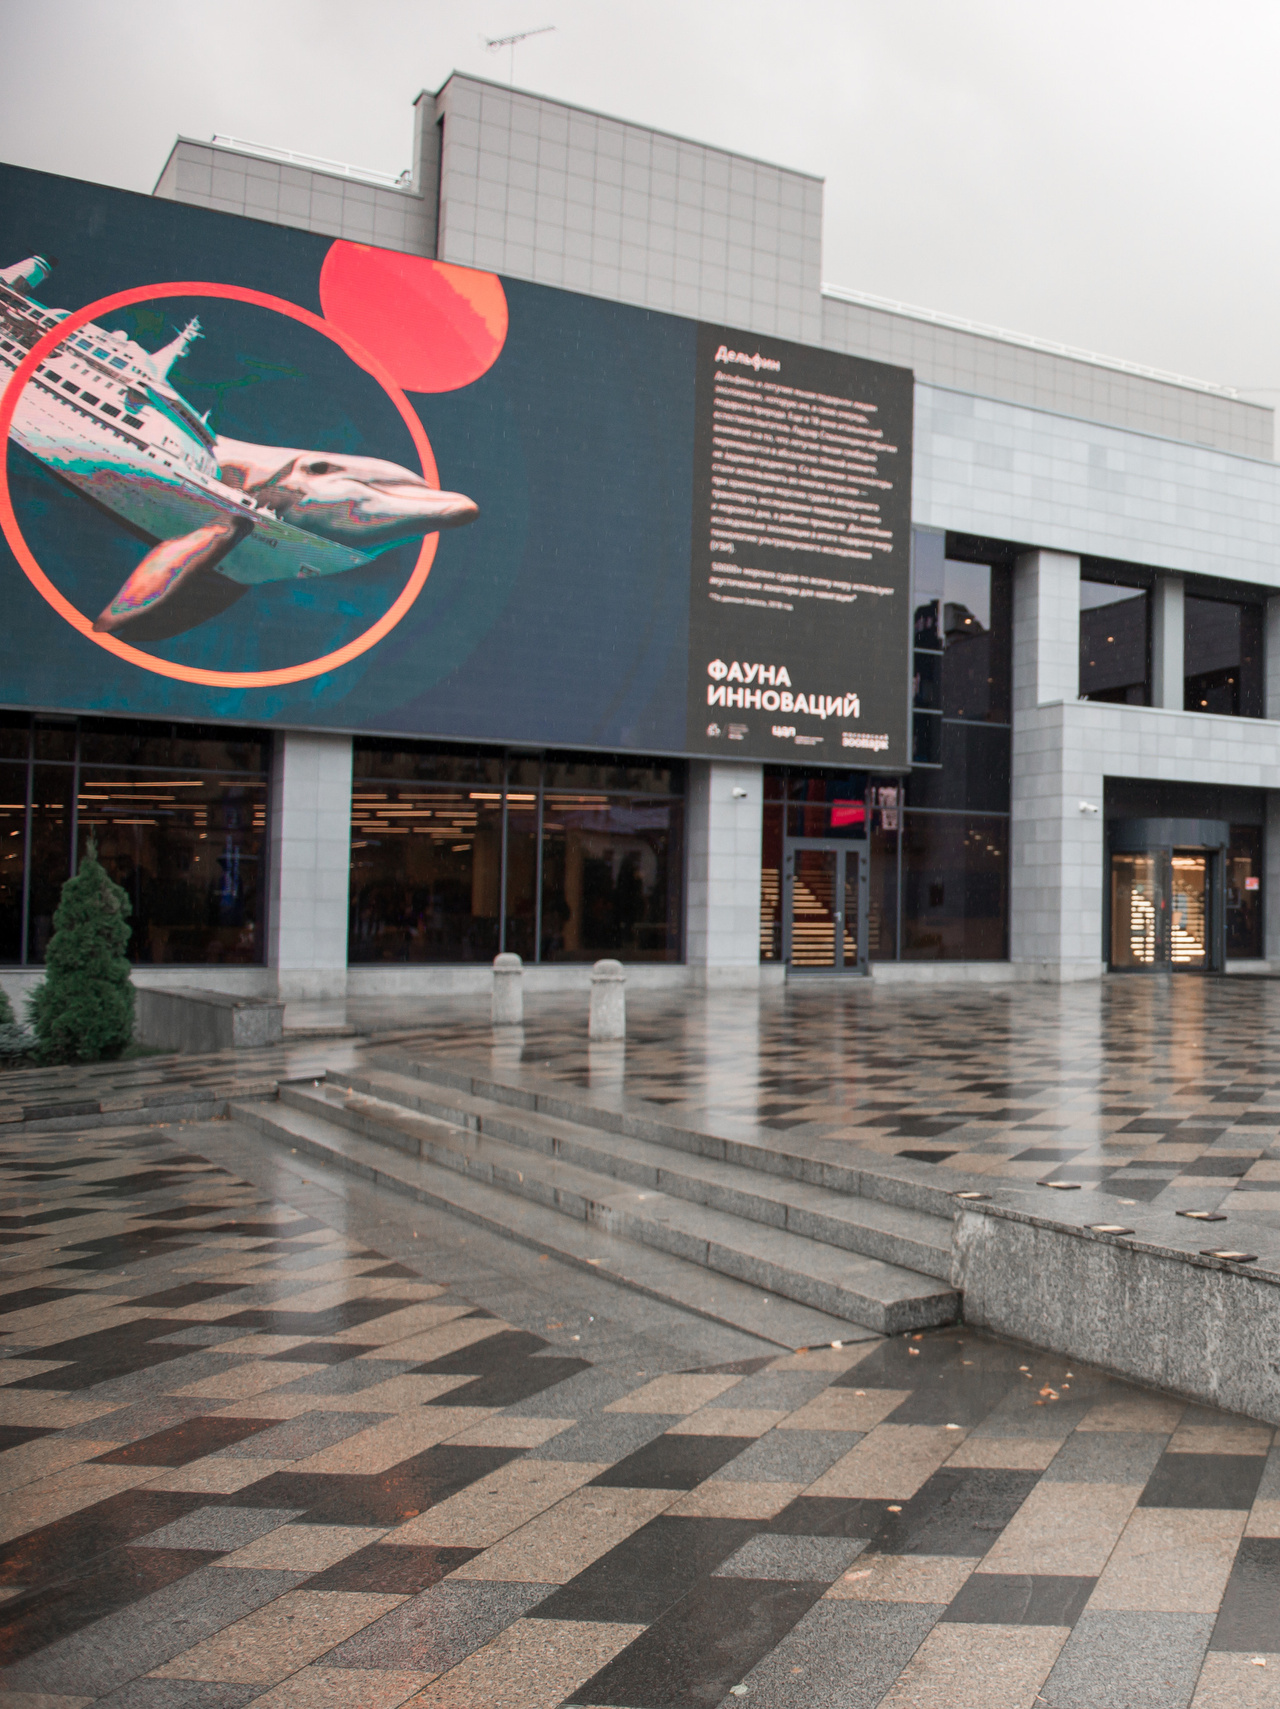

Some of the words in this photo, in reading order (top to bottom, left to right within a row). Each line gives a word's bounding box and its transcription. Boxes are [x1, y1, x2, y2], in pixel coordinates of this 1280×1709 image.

[714, 345, 781, 372] Дельфин
[708, 659, 791, 687] ФАУНА
[707, 684, 860, 719] ИННОВАЦИЙ
